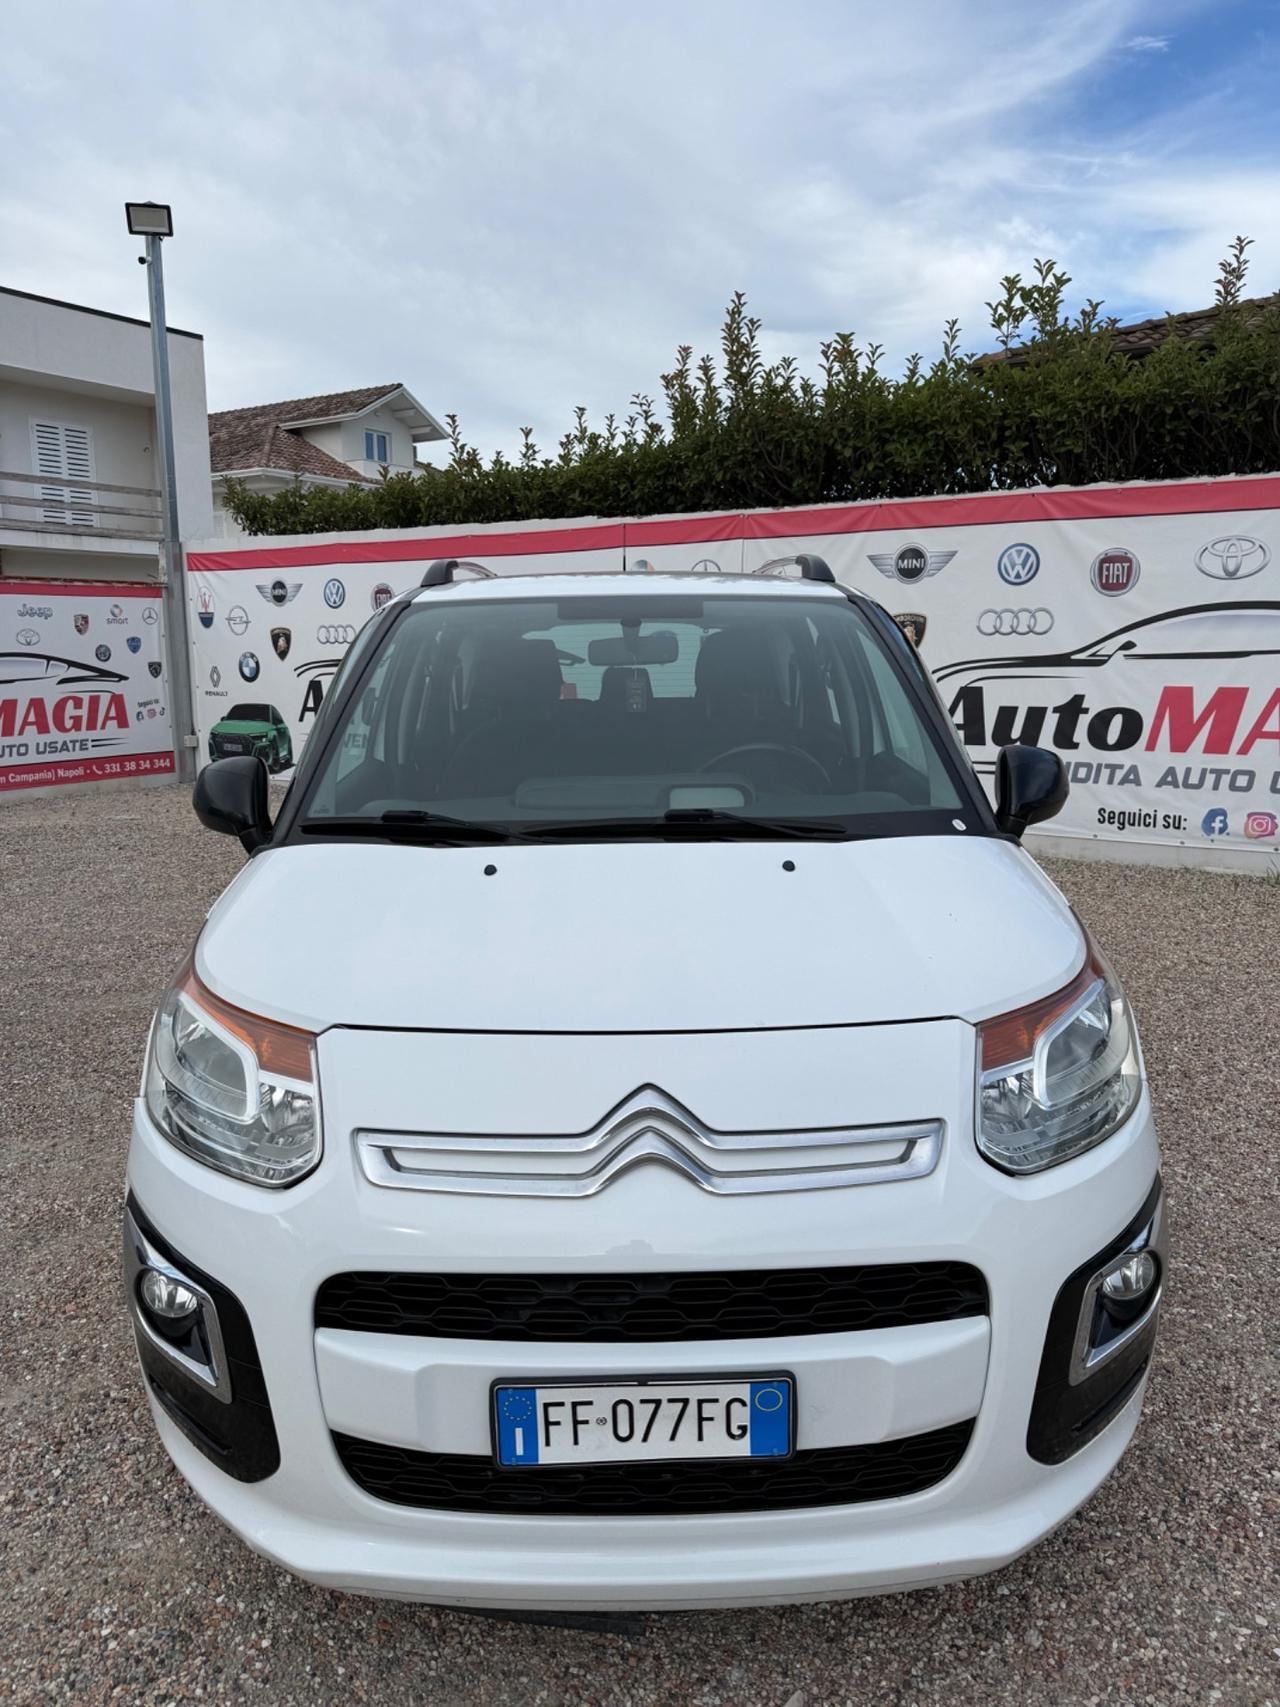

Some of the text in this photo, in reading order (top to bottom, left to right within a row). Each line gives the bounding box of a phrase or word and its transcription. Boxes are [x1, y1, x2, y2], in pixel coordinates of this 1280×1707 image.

[897, 558, 925, 569] MINI
[1102, 562, 1130, 583] FIAT
[36, 738, 90, 756] USATE
[57, 767, 85, 779] Napoli
[104, 764, 121, 774] 331
[124, 761, 137, 771] 38
[139, 760, 151, 770] 34
[153, 758, 171, 768] 344
[1155, 766, 1257, 793] AUTO
[1097, 807, 1188, 831] Seguici su:
